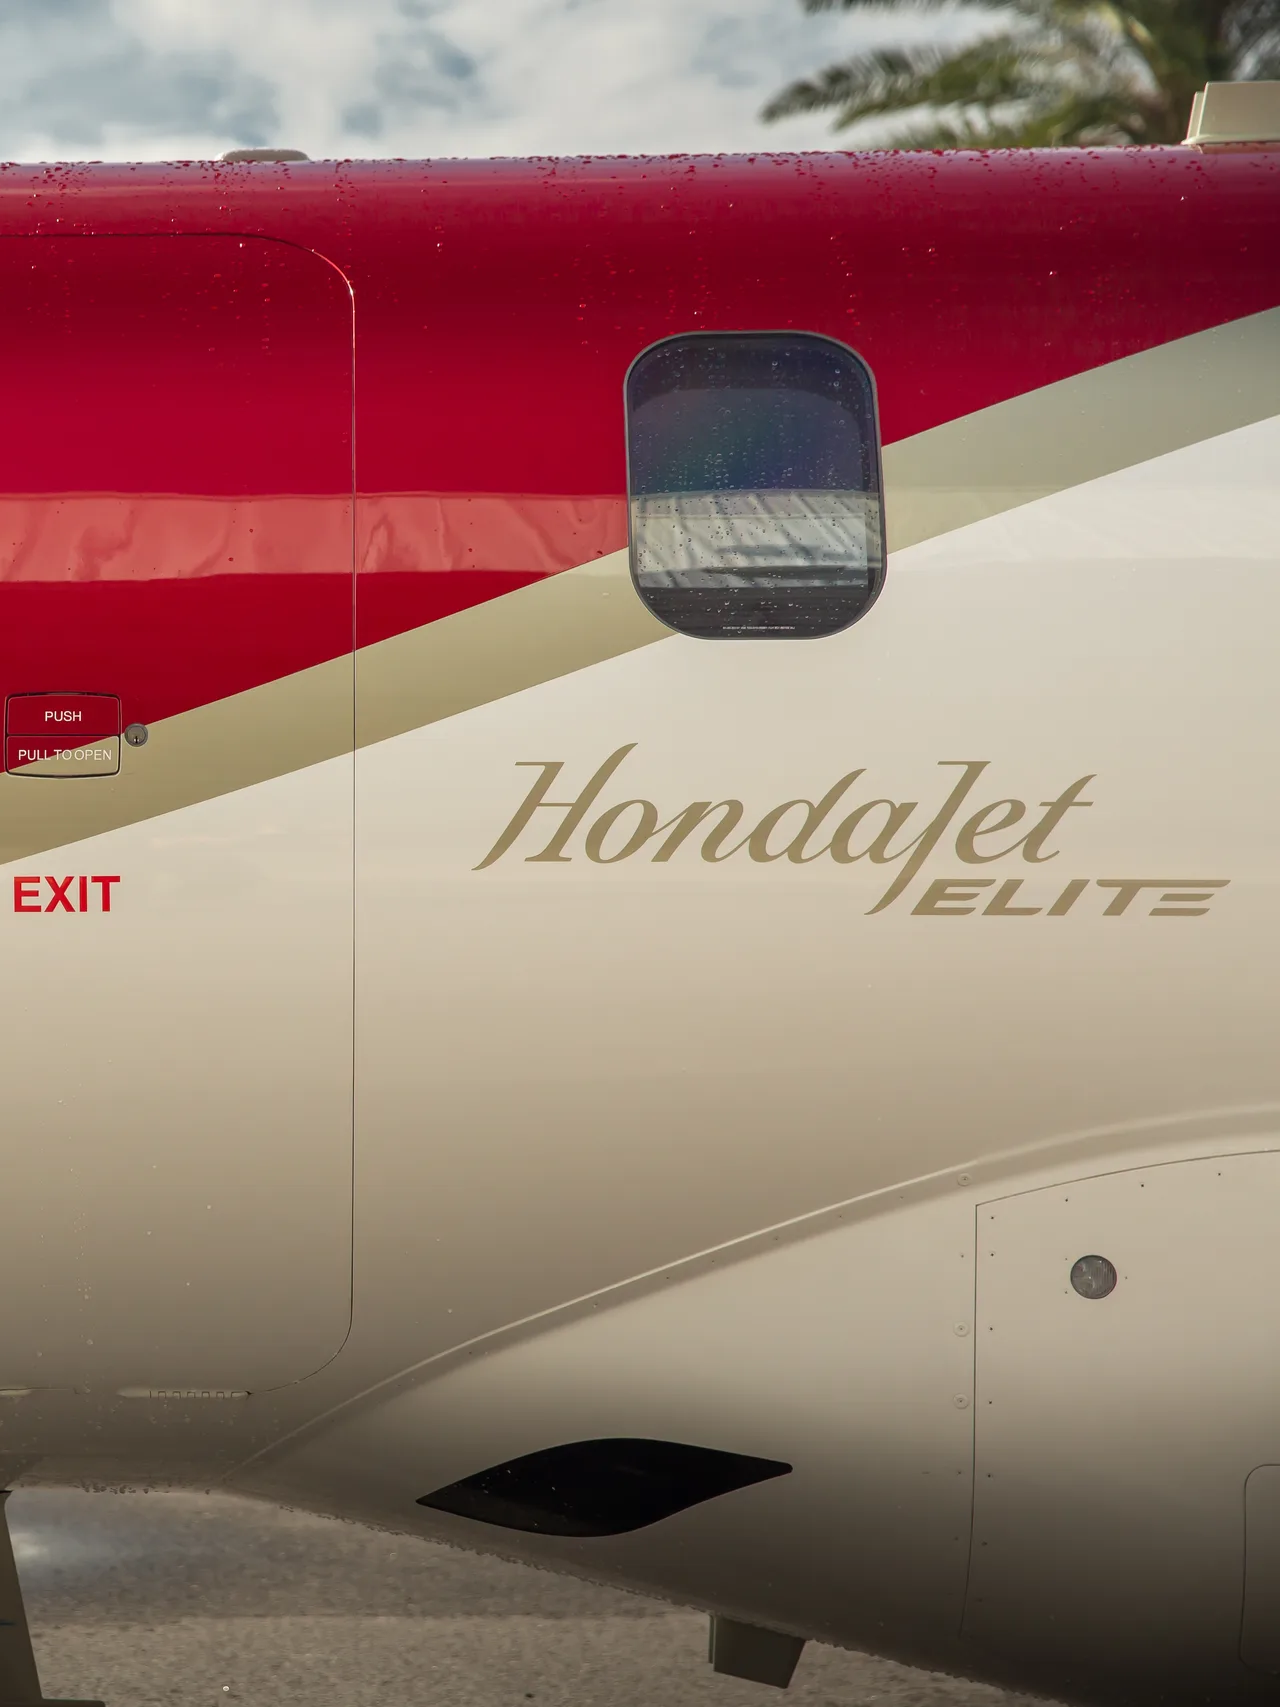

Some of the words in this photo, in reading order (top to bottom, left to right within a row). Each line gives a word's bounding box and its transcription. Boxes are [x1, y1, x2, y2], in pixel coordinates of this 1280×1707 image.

[44, 710, 82, 722] PUSH
[18, 749, 51, 761] PULL
[53, 749, 73, 761] TO
[74, 749, 112, 761] OPEN
[471, 743, 1097, 916] HondaJet
[13, 875, 121, 913] EXIT
[909, 878, 1232, 917] ELITE
